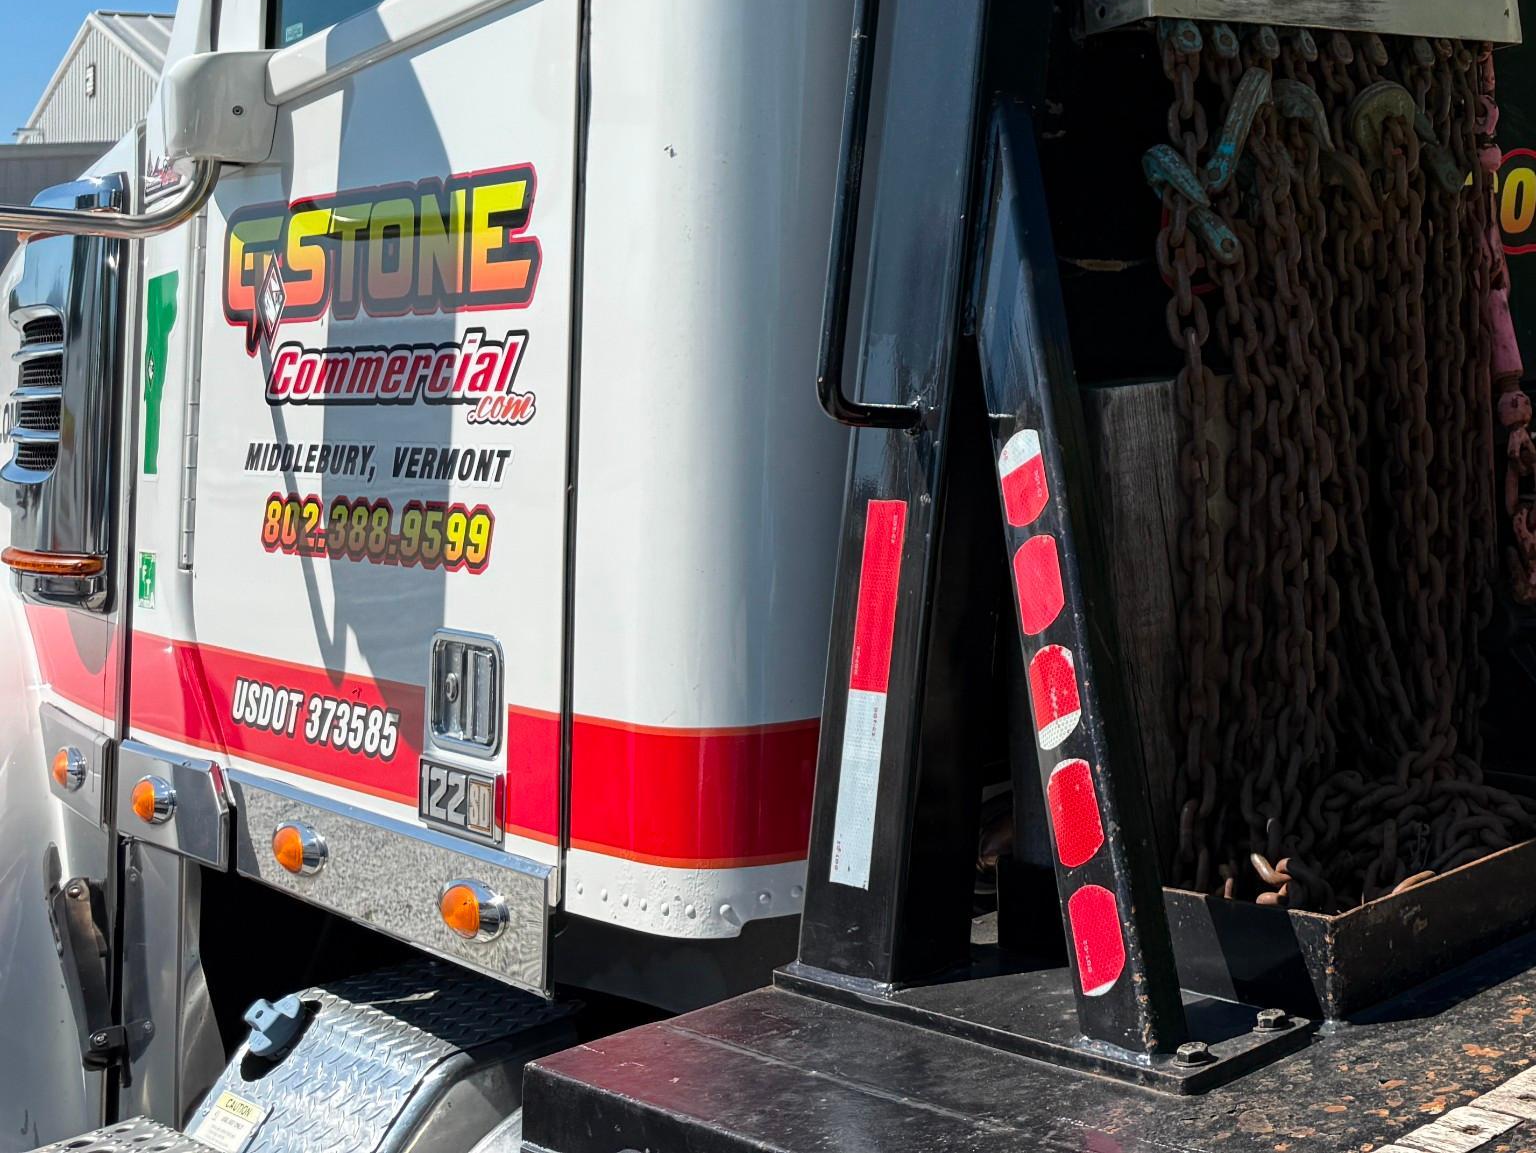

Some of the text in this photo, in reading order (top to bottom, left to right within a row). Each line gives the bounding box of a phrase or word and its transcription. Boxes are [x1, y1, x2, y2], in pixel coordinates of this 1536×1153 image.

[268, 334, 526, 402] Commercial
[245, 441, 512, 484] MIDDLEBURY, VERMONT
[264, 497, 491, 568] 802.388.9599
[231, 677, 399, 758] USDOT 373585
[421, 764, 491, 829] 122 SD
[225, 1098, 252, 1116] CAUTION
